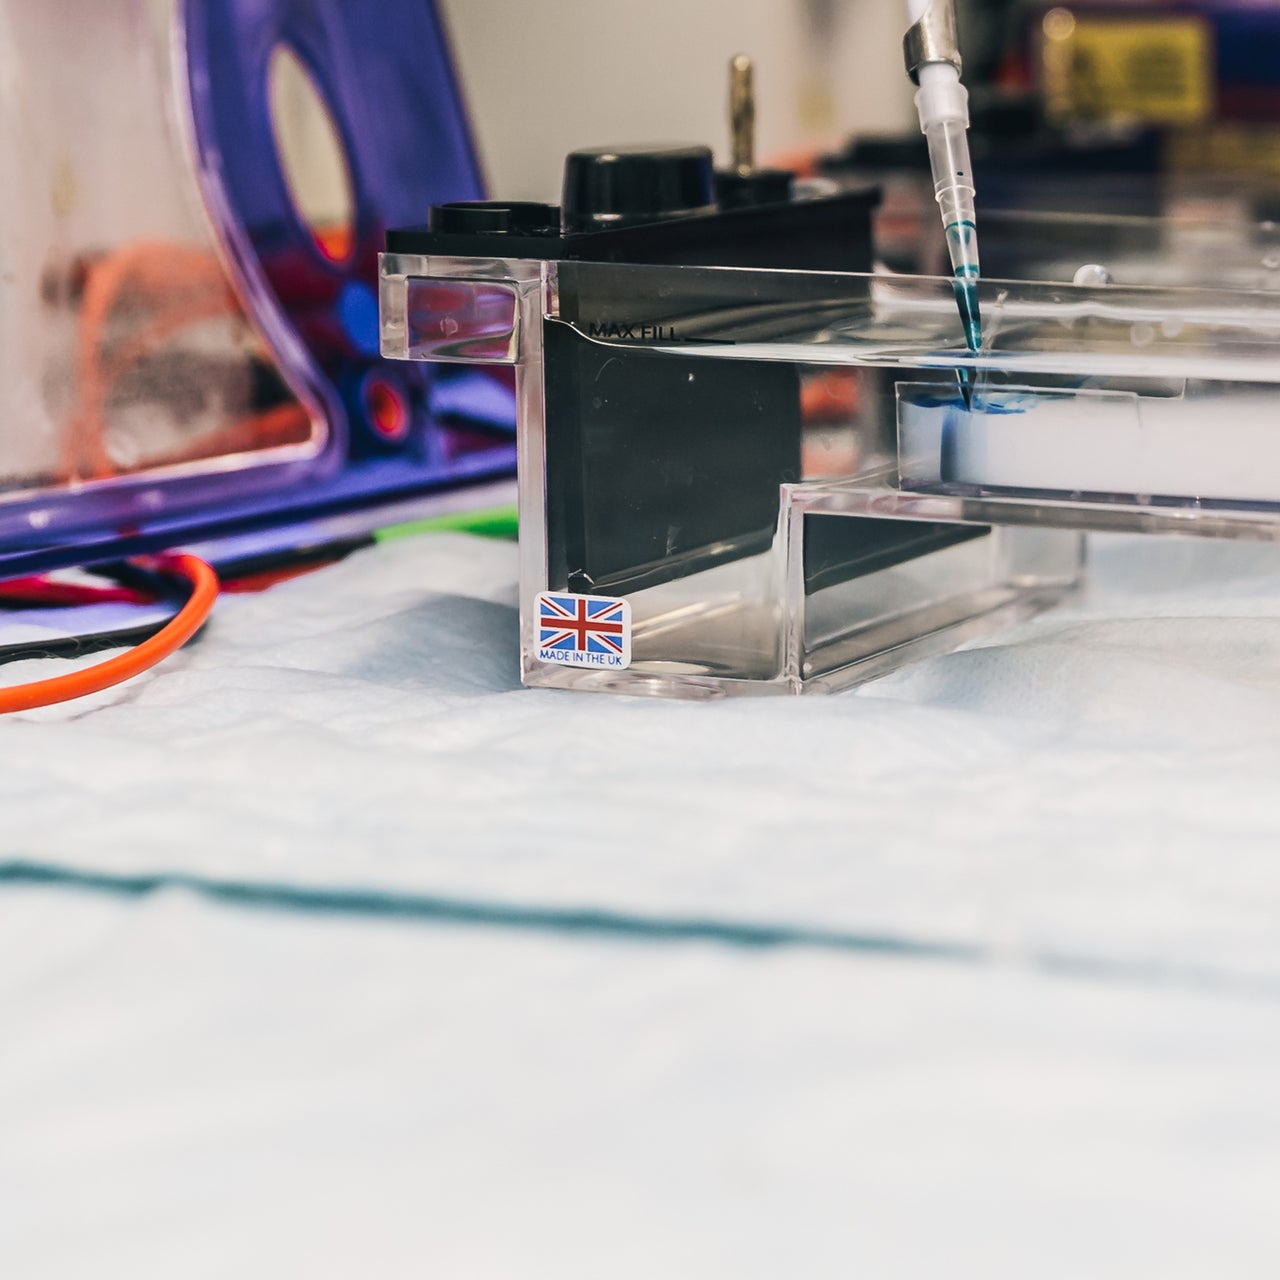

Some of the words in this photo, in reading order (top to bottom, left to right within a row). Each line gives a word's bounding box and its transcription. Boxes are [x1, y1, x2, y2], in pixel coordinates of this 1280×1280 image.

[588, 323, 635, 338] MAX
[641, 326, 681, 341] FILL
[540, 650, 570, 661] MADE
[573, 652, 584, 662] IN
[586, 652, 605, 664] THE
[608, 656, 622, 665] UK
